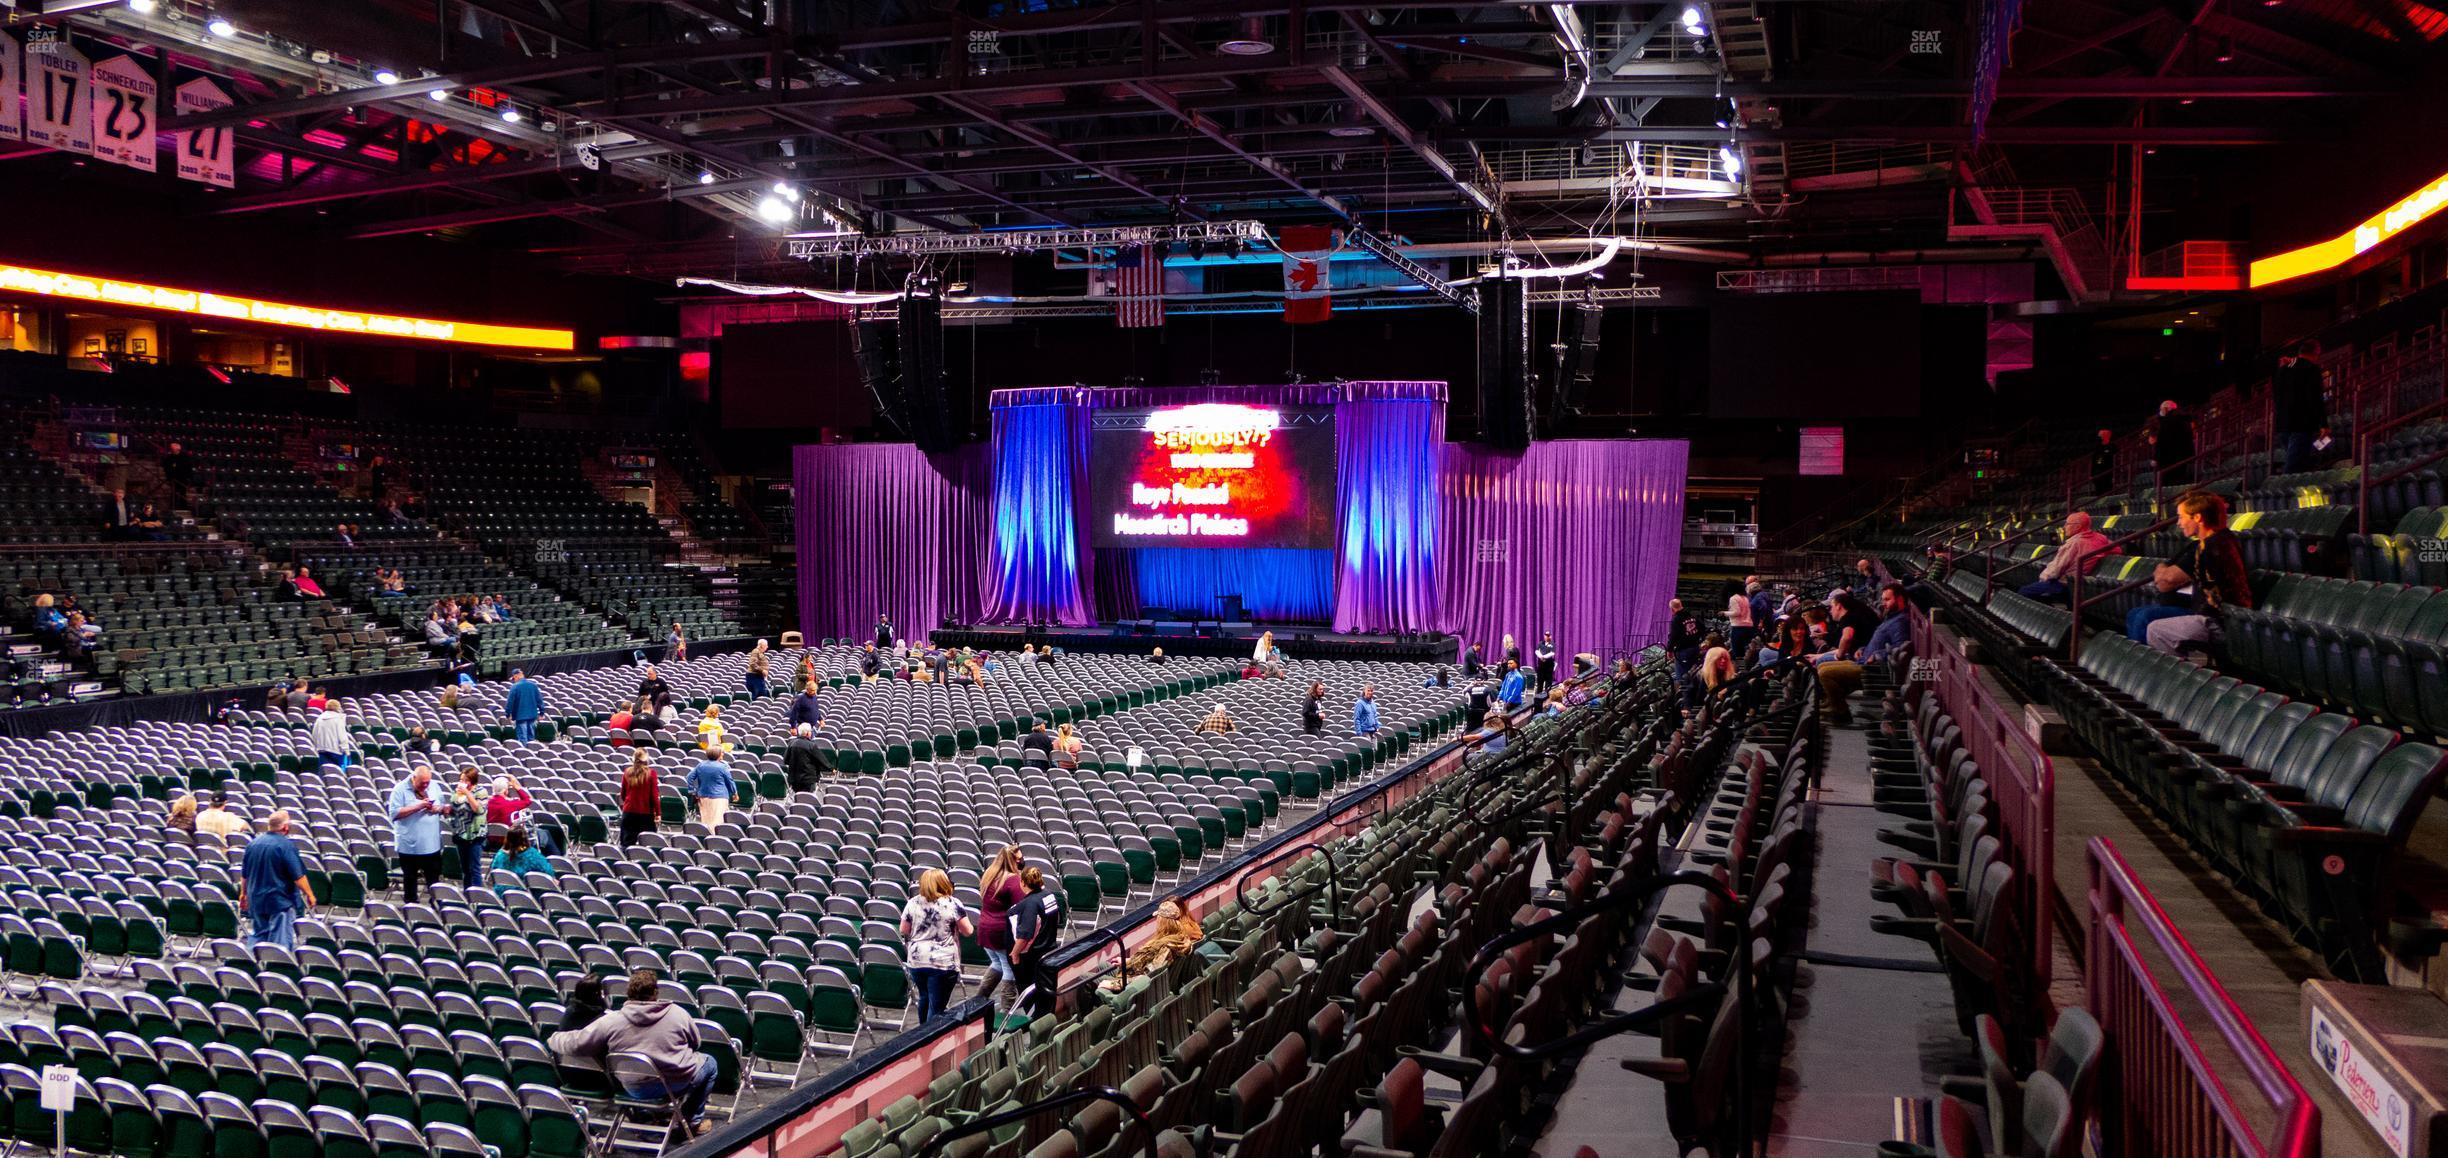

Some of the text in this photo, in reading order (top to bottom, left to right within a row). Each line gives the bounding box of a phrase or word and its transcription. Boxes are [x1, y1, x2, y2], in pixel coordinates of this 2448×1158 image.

[41, 53, 79, 72] TOBLER
[96, 68, 155, 95] SCHNEEKLOTH
[44, 70, 77, 126] 17
[106, 88, 146, 140] 23
[50, 1073, 70, 1082] DDD
